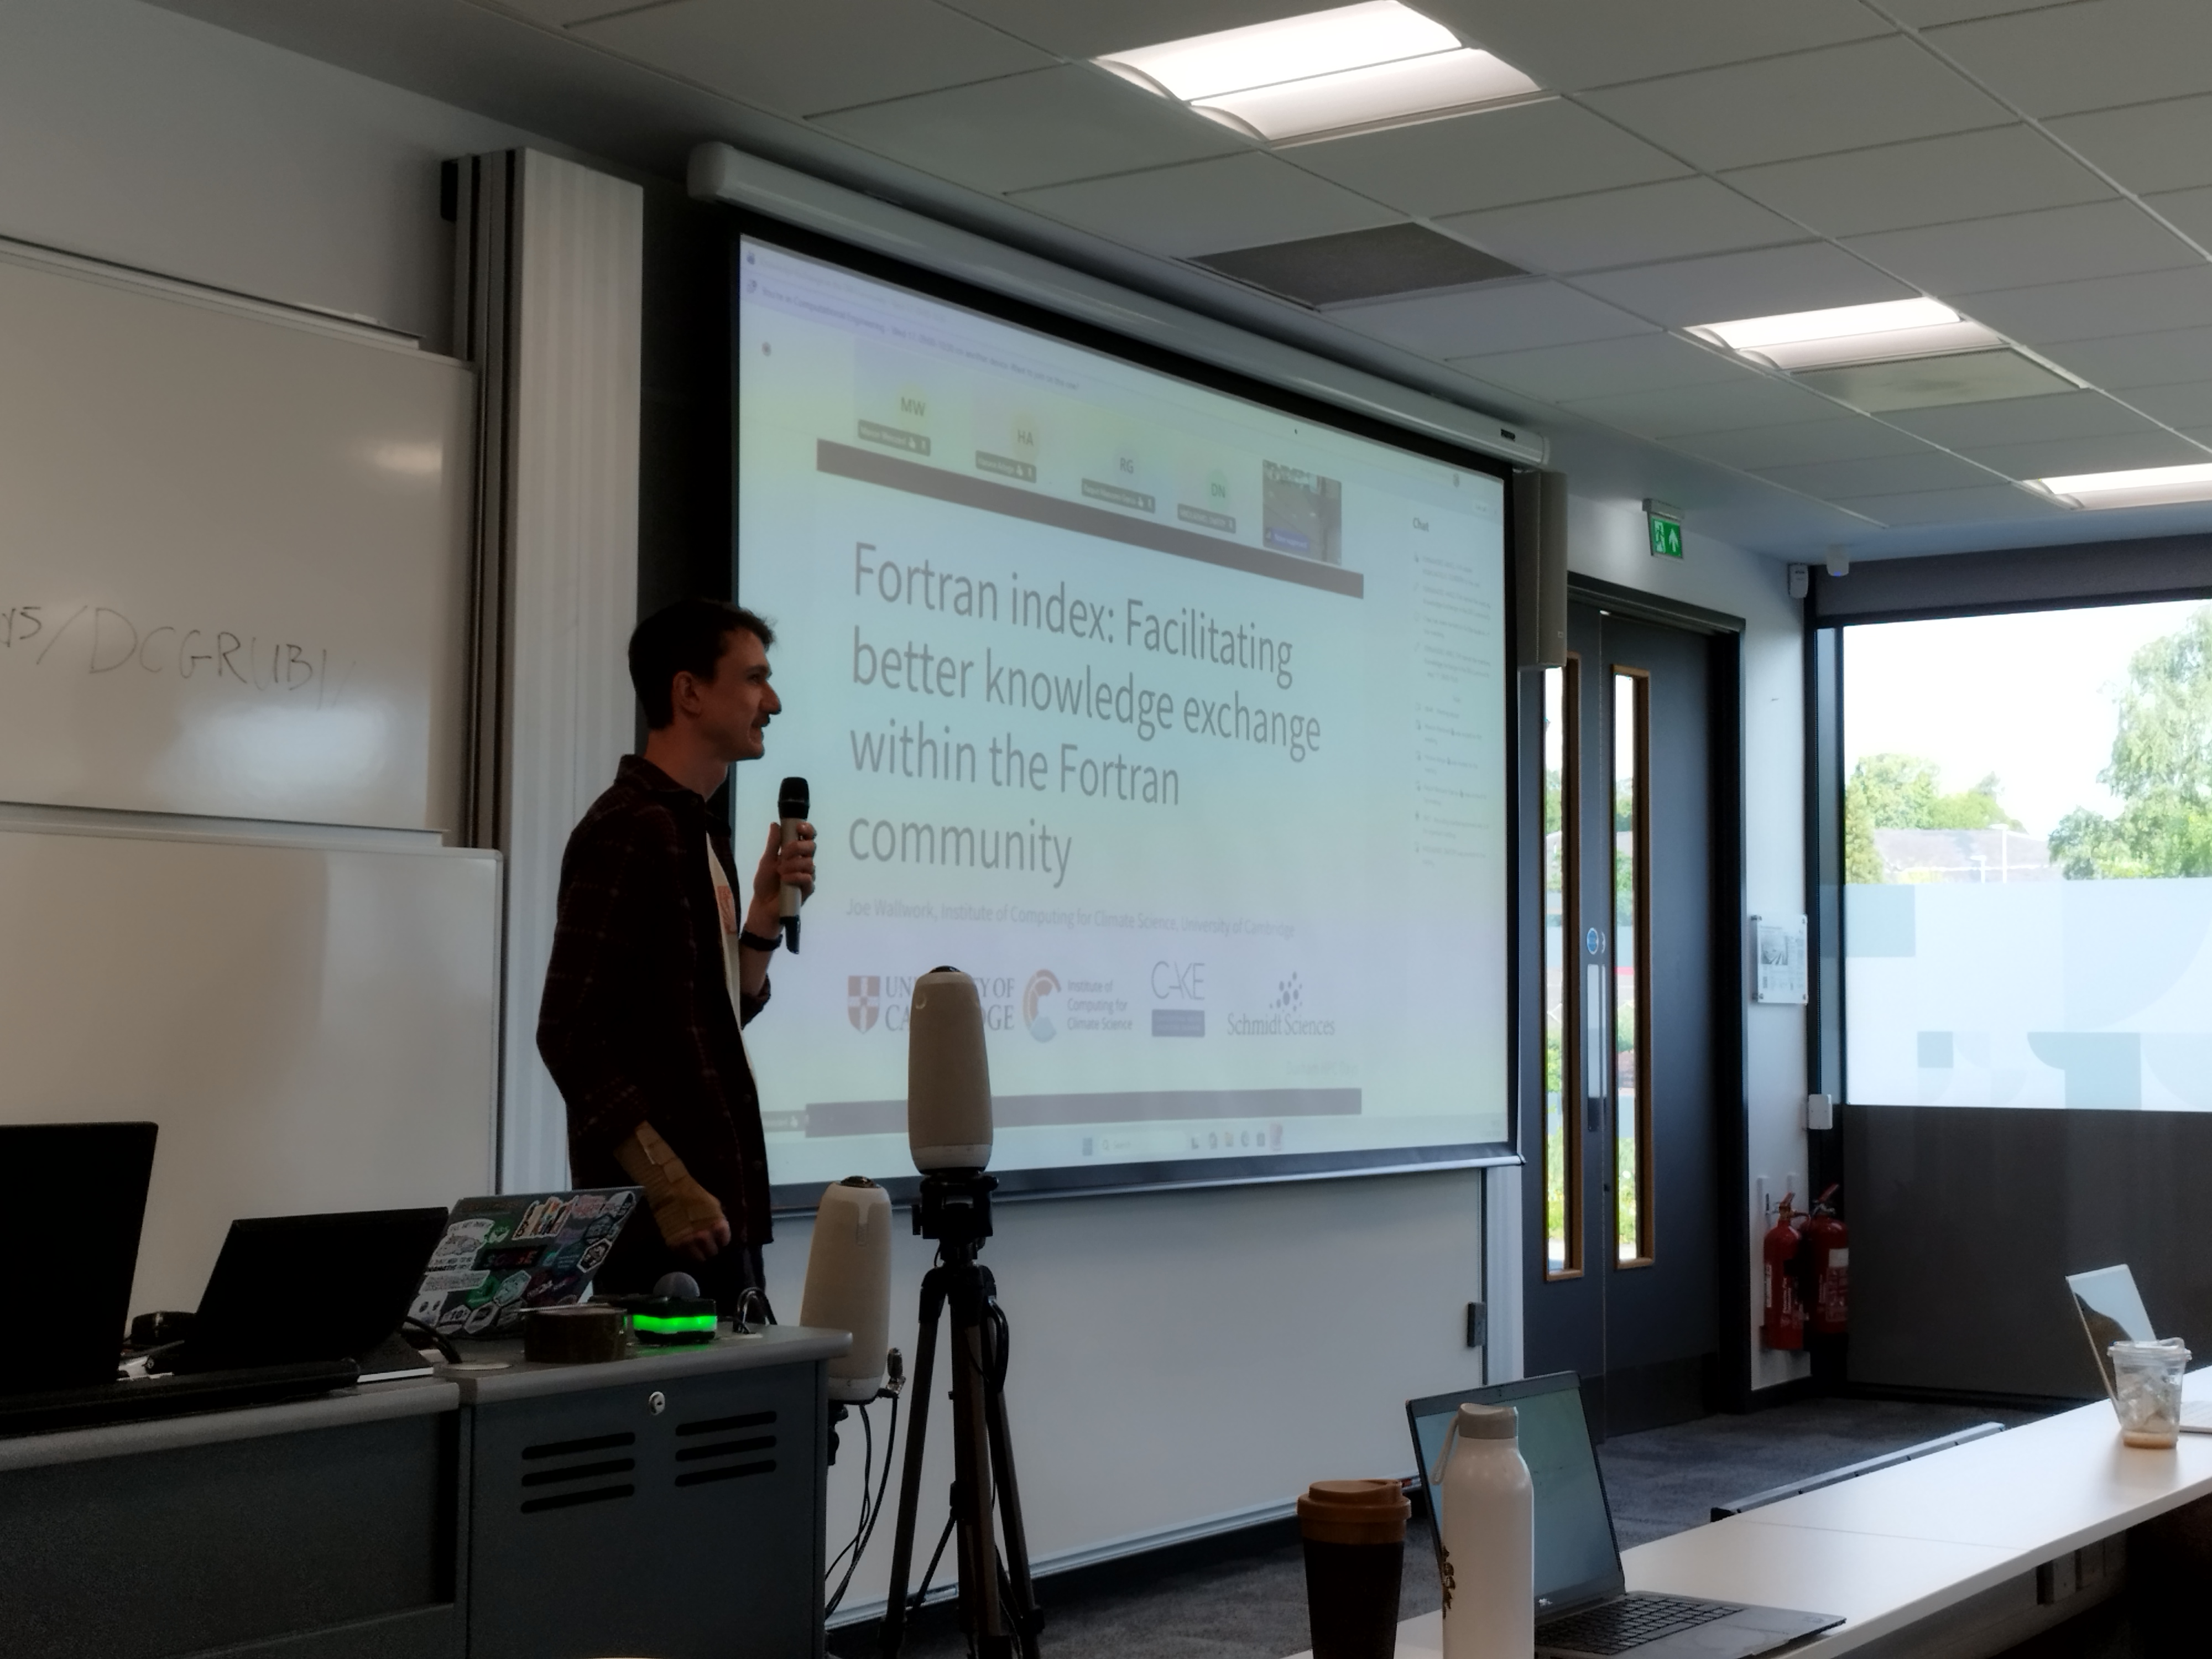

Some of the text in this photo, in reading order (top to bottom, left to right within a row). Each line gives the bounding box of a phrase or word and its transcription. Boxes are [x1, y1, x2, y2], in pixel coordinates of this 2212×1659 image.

[900, 396, 926, 417] MW
[1017, 430, 1034, 447] HA
[1119, 457, 1134, 475] RG
[1211, 483, 1225, 500] DN
[1412, 517, 1430, 533] Chat
[855, 541, 1293, 690] Fortran index: Facilitating
[853, 625, 1321, 763] better knowledge exchange
[851, 719, 1179, 806] within the Fortran
[849, 818, 1072, 889] community
[846, 898, 1295, 941] Joe Wallwork, Institute of Computing for Climate Science, University of Cambridge
[993, 977, 1015, 998] OF
[1067, 998, 1114, 1016] Computing
[1102, 1016, 1133, 1031] Science
[1227, 1012, 1282, 1036] Schmidt
[1284, 1013, 1335, 1036] Sciences
